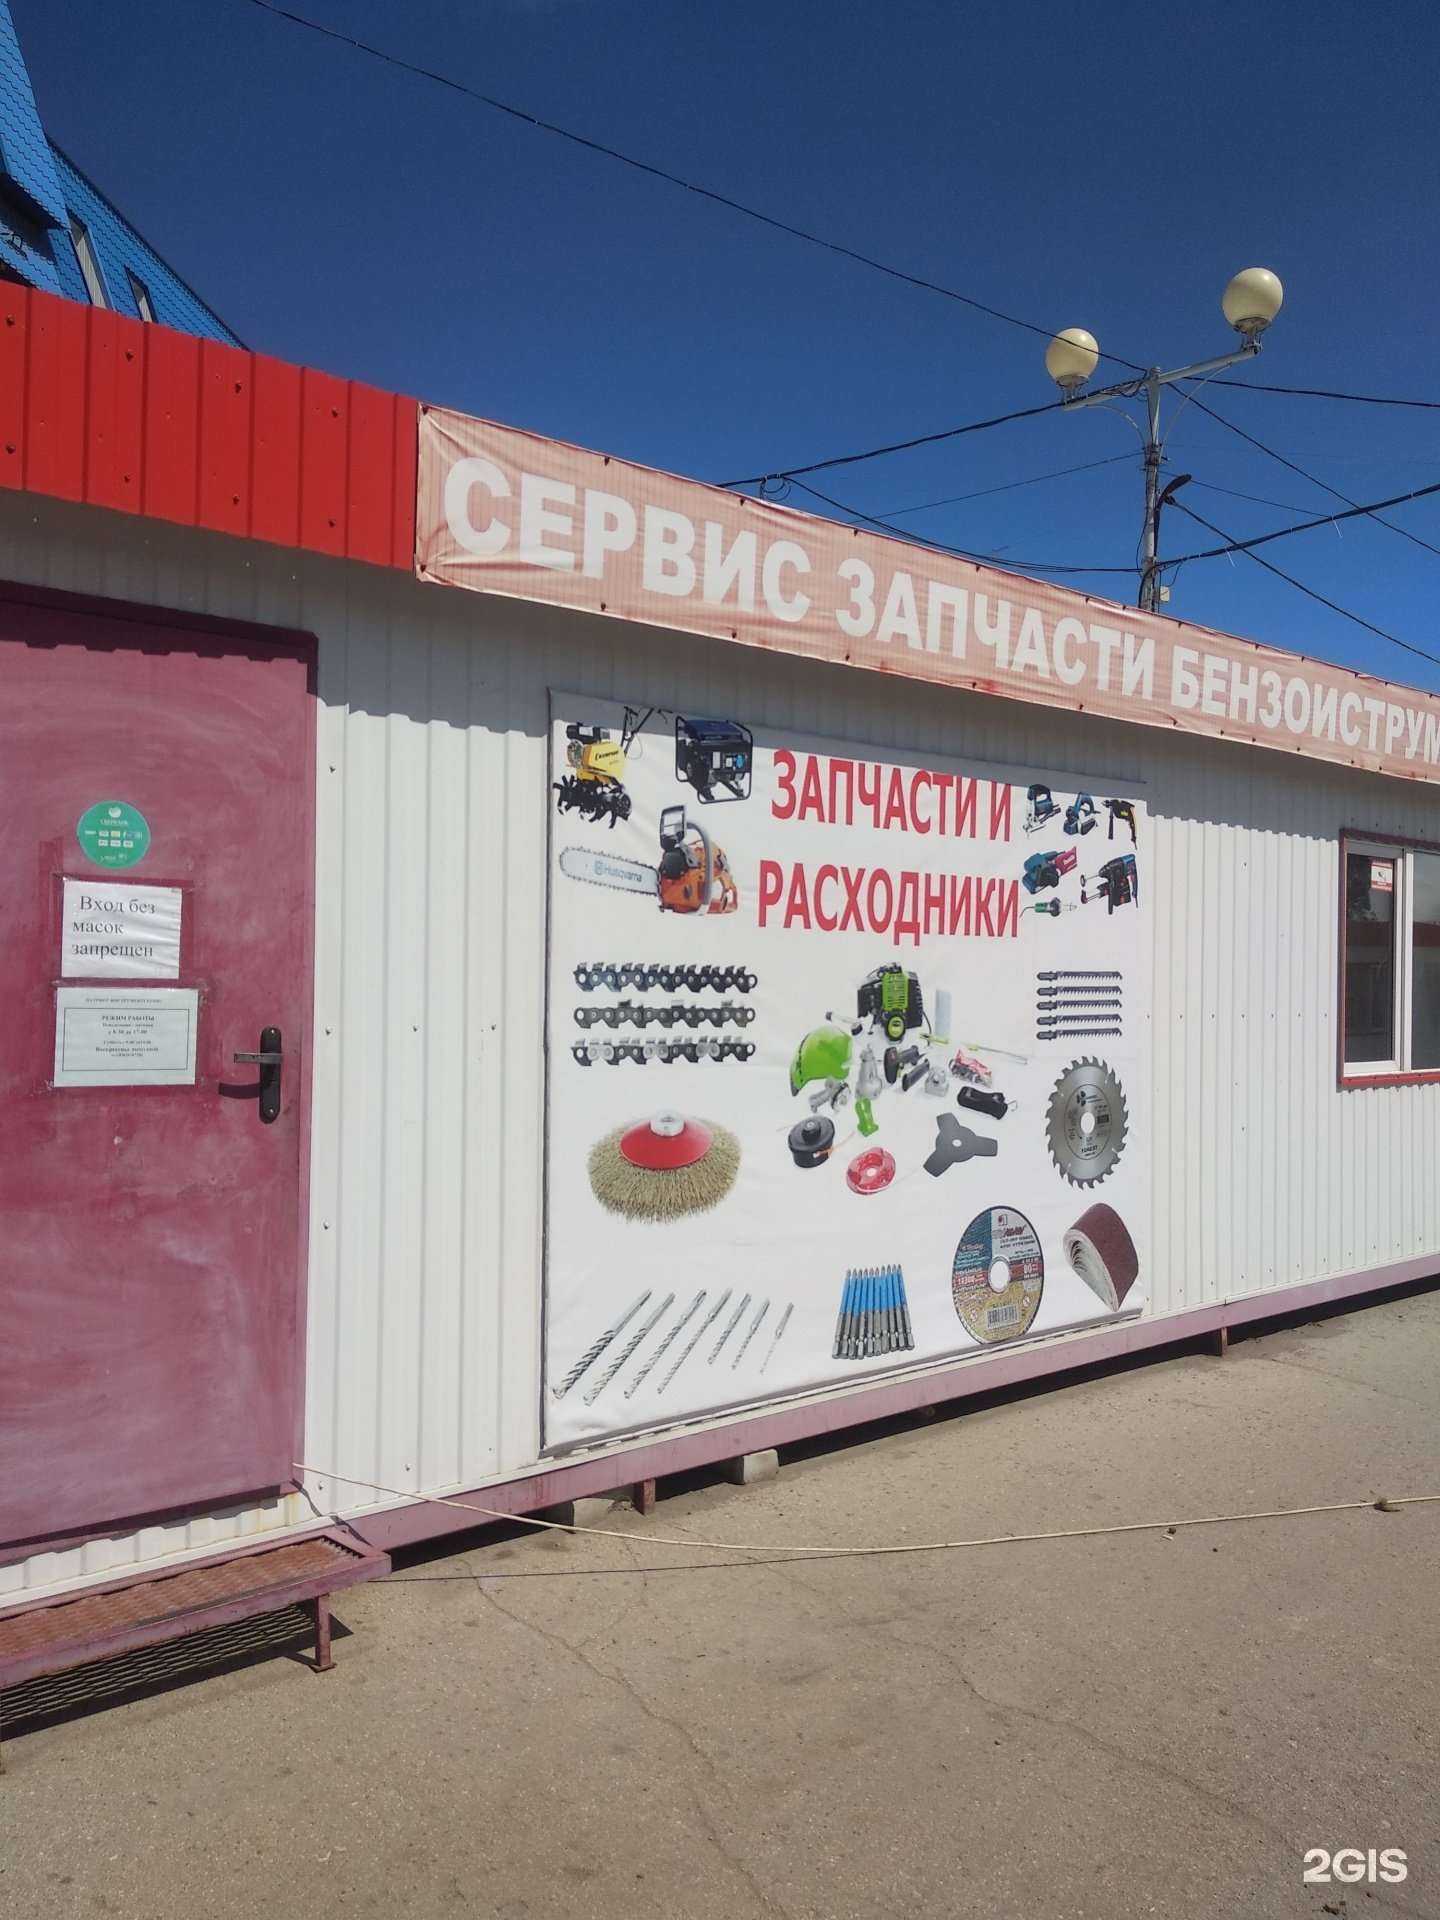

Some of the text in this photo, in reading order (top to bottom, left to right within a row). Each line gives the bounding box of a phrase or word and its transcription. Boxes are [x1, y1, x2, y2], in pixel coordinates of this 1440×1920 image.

[444, 457, 1440, 766] СЕРВИС ЗАПЧАСТИ БЕНЗОИСТРУМ
[771, 749, 1012, 842] ЗАПЧАСТИ И
[73, 921, 125, 934] масок
[80, 895, 156, 914] Вход без
[758, 859, 1019, 946] РАСХОДНИКИ
[71, 943, 153, 959] запрещен
